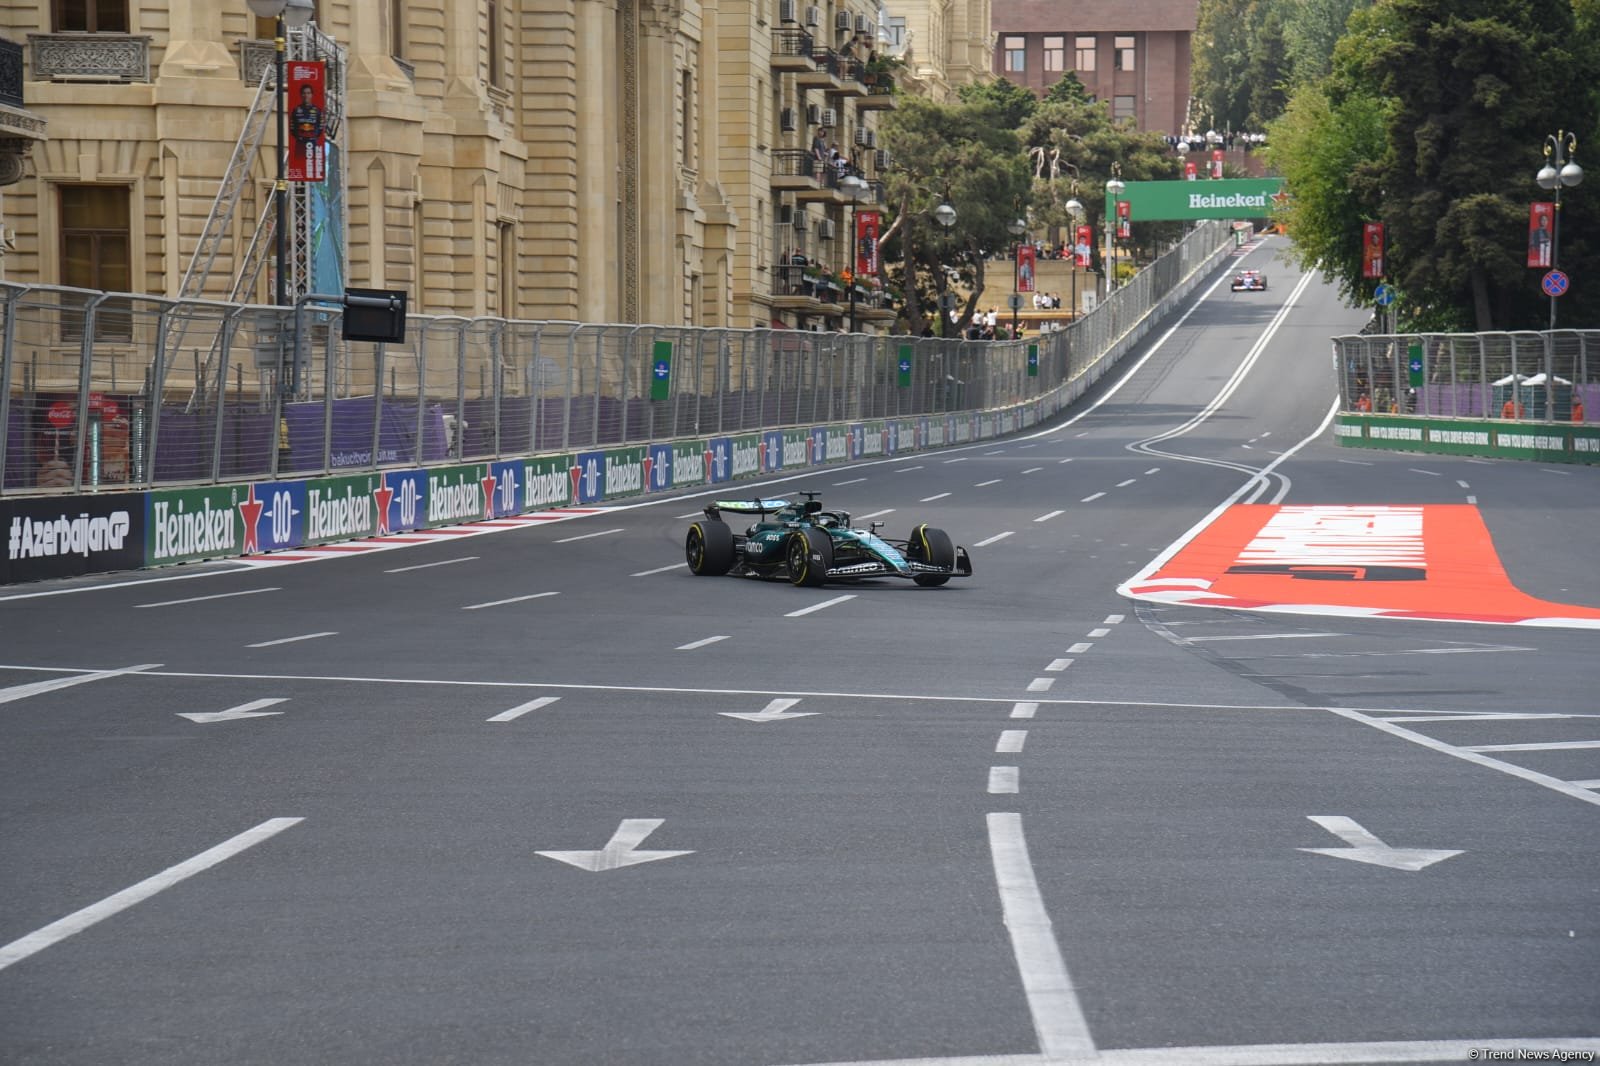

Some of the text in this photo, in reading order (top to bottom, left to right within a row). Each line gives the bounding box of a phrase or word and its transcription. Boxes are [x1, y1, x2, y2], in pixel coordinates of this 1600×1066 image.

[1189, 193, 1266, 208] Heineken
[525, 463, 568, 507] Heineken
[606, 455, 640, 494] Heineken
[308, 486, 371, 540] Heineken
[428, 474, 480, 522] Heineken
[154, 497, 236, 558] Heineken
